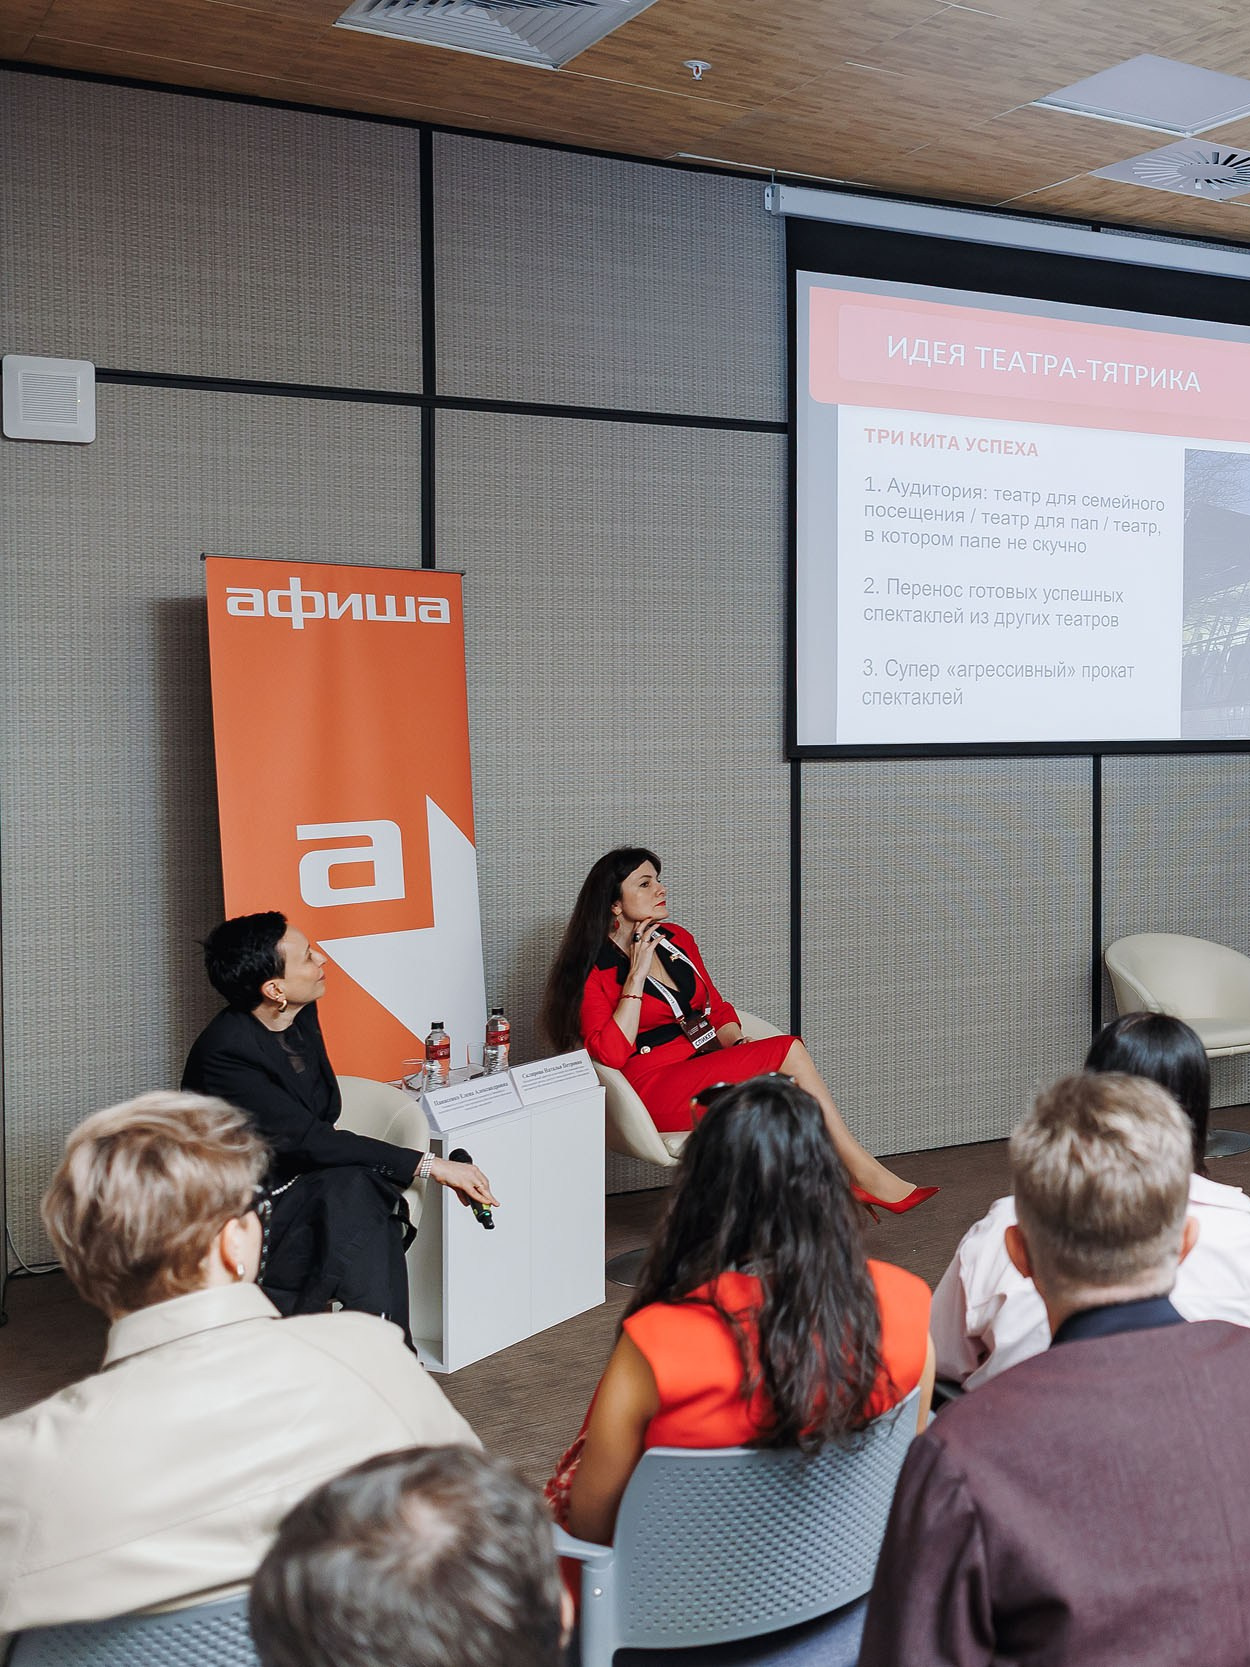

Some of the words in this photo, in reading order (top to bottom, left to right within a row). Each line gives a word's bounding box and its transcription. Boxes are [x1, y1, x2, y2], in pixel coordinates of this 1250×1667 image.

[888, 335, 966, 367] ИДЕЯ
[974, 345, 1201, 392] ТЕАТРА-ТЯТРИКА
[864, 427, 904, 446] ТРИ
[909, 431, 960, 450] КИТА
[965, 436, 1039, 457] УСПЕХА
[864, 475, 881, 493] 1.
[887, 477, 988, 501] Аудитория:
[993, 486, 1041, 505] театр
[1046, 491, 1076, 507] для
[1081, 493, 1165, 512] семейного
[864, 503, 965, 523] посещения
[981, 511, 1029, 530] театр
[1034, 514, 1065, 531] для
[1071, 515, 1099, 531] пап
[1113, 519, 1161, 537] театр,
[864, 529, 875, 542] в
[881, 530, 954, 549] котором
[960, 534, 1001, 549] папе
[1007, 537, 1027, 551] не
[1032, 537, 1087, 556] скучно
[226, 577, 451, 630] афиша
[863, 577, 879, 594] 2.
[887, 578, 963, 599] Перенос
[968, 583, 1038, 600] готовых
[1043, 586, 1124, 604] успешных
[863, 607, 964, 624] спектаклей
[970, 609, 989, 625] из
[993, 609, 1050, 629] других
[1056, 612, 1119, 630] театров
[862, 658, 878, 677] 3.
[884, 659, 940, 681] Супер
[946, 661, 1076, 681] «агрессивный»
[1082, 663, 1135, 682] прокат
[862, 688, 963, 705] спектаклей
[694, 1031, 714, 1046] СПИКЕР
